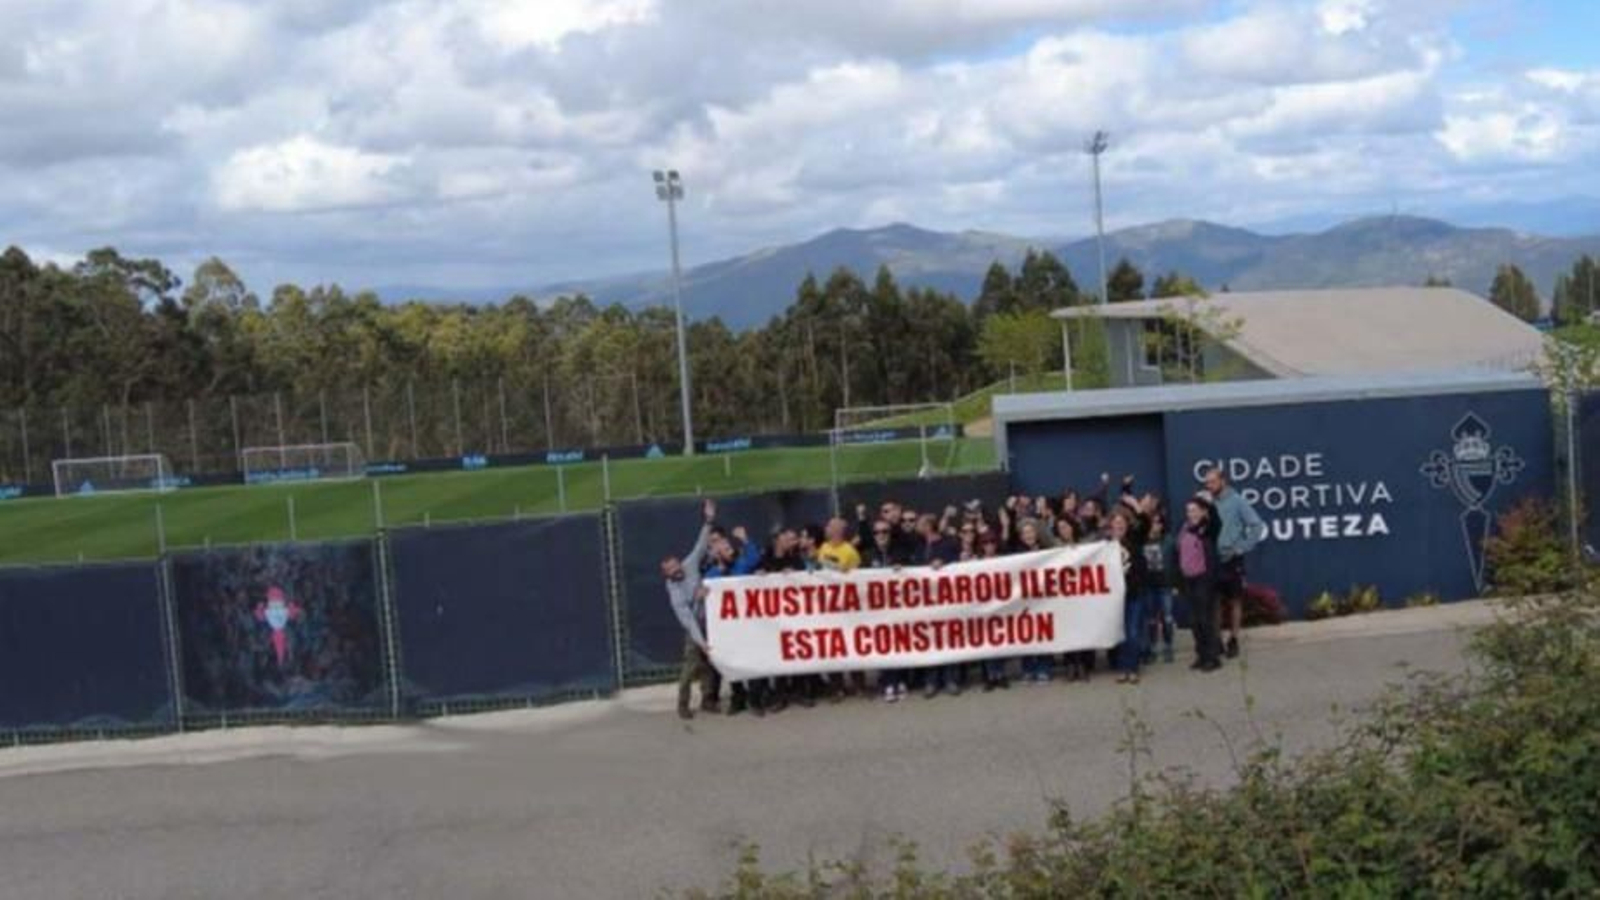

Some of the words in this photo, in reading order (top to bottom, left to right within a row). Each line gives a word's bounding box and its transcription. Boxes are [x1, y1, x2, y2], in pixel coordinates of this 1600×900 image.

[1240, 481, 1393, 511] PORTIVA
[720, 589, 740, 620] A
[745, 582, 861, 618] XUSTIZA
[866, 572, 1012, 611] DECLAROU
[1020, 564, 1110, 599] ILEGAL
[778, 627, 848, 661] ESTA
[852, 608, 1055, 657] CONSTRUCIÓN
